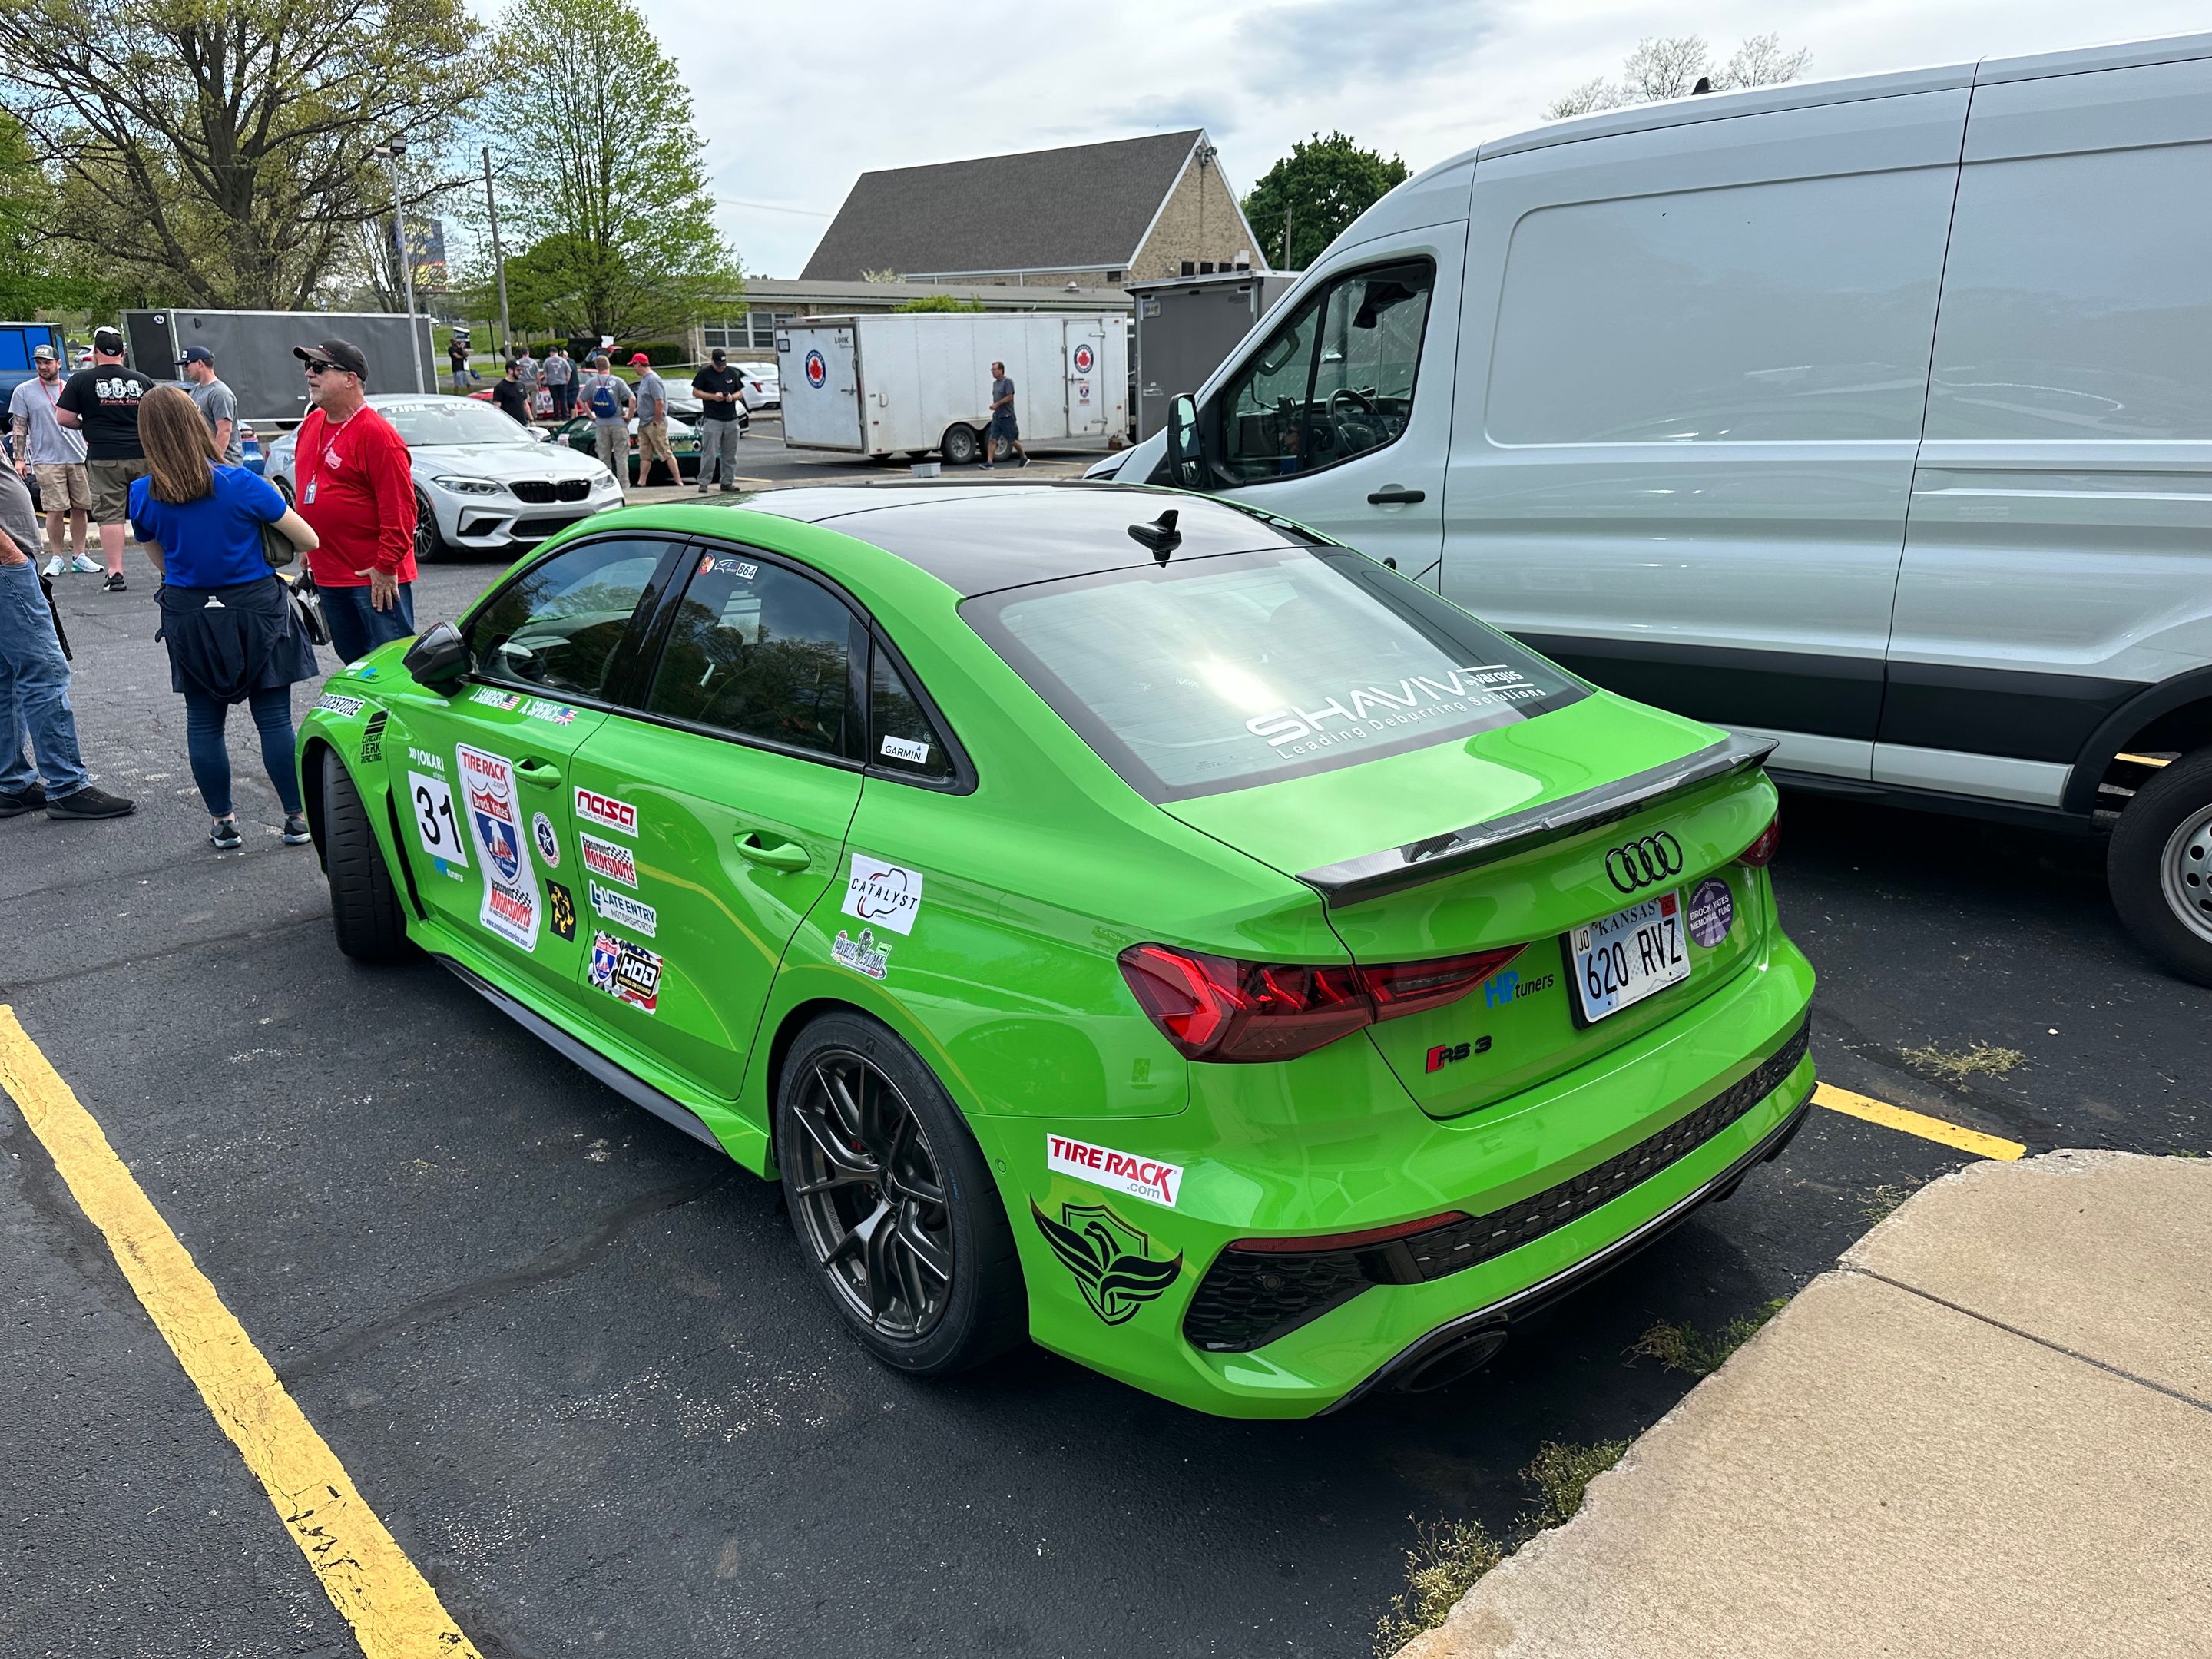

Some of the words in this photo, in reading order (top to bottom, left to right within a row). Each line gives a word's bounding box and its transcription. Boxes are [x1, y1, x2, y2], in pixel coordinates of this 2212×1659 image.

[387, 404, 427, 413] TIRE
[737, 565, 757, 577] 864
[1462, 678, 1479, 687] by
[1471, 671, 1524, 684] vargus
[1245, 671, 1466, 747] SHAVIV
[362, 733, 382, 743] CIRCUIT
[1275, 724, 1367, 760] Leading
[1368, 699, 1467, 730] Deburring
[1468, 688, 1547, 706] Solutions
[361, 741, 381, 755] JERK
[361, 753, 382, 764] RACING
[417, 750, 445, 771] JOKARI
[885, 745, 922, 760] GARMIN
[462, 753, 482, 772] TIRE
[482, 760, 510, 792] RACK
[474, 794, 491, 812] Brock
[578, 791, 634, 826] nasa
[416, 786, 462, 853] 31
[492, 835, 512, 861] LAP
[584, 846, 635, 882] Motorsports
[490, 888, 531, 928] Motorsports
[602, 890, 624, 911] LATE
[625, 900, 654, 923] ENTRY
[851, 878, 918, 909] CATALYST
[1690, 905, 1712, 921] BROCK
[1712, 894, 1730, 909] YATES
[611, 908, 654, 934] MOTORSPORTS
[1598, 900, 1656, 936] KANSAS
[1690, 911, 1718, 932] MEMORIAL
[1718, 904, 1731, 917] FUND
[1578, 930, 1590, 952] JO
[621, 955, 657, 987] HOD
[1587, 942, 1629, 999] 620
[1637, 918, 1682, 977] RVZ
[1484, 970, 1519, 1008] HP
[1515, 973, 1555, 998] tuners
[1436, 1042, 1471, 1067] RS
[1475, 1035, 1492, 1054] 3
[1050, 1137, 1104, 1171] TIRE
[1104, 1153, 1174, 1203] RACK
[1127, 1181, 1161, 1199] .com
